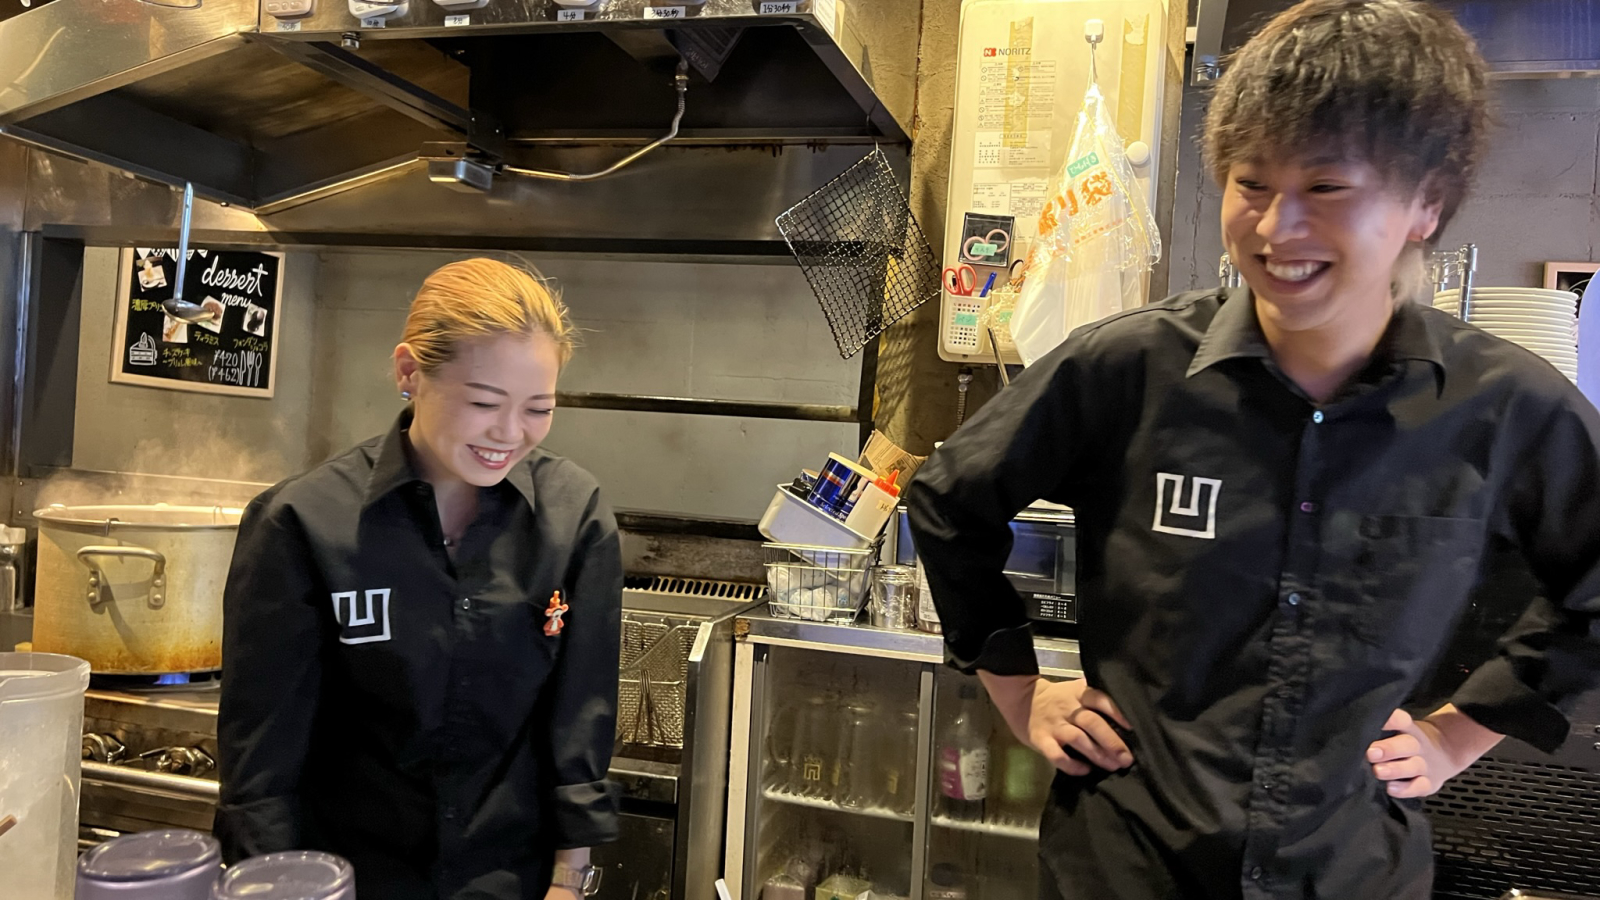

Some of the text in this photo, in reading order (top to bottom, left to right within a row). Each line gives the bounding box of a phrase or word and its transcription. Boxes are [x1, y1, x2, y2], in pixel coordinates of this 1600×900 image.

[998, 47, 1032, 56] NORITZ
[201, 254, 269, 297] dessert
[131, 298, 164, 313] 濃厚プリ
[221, 292, 252, 309] menu
[194, 330, 219, 346] ティラミス
[213, 349, 239, 367] ¥420
[208, 365, 240, 384] (¥462)
